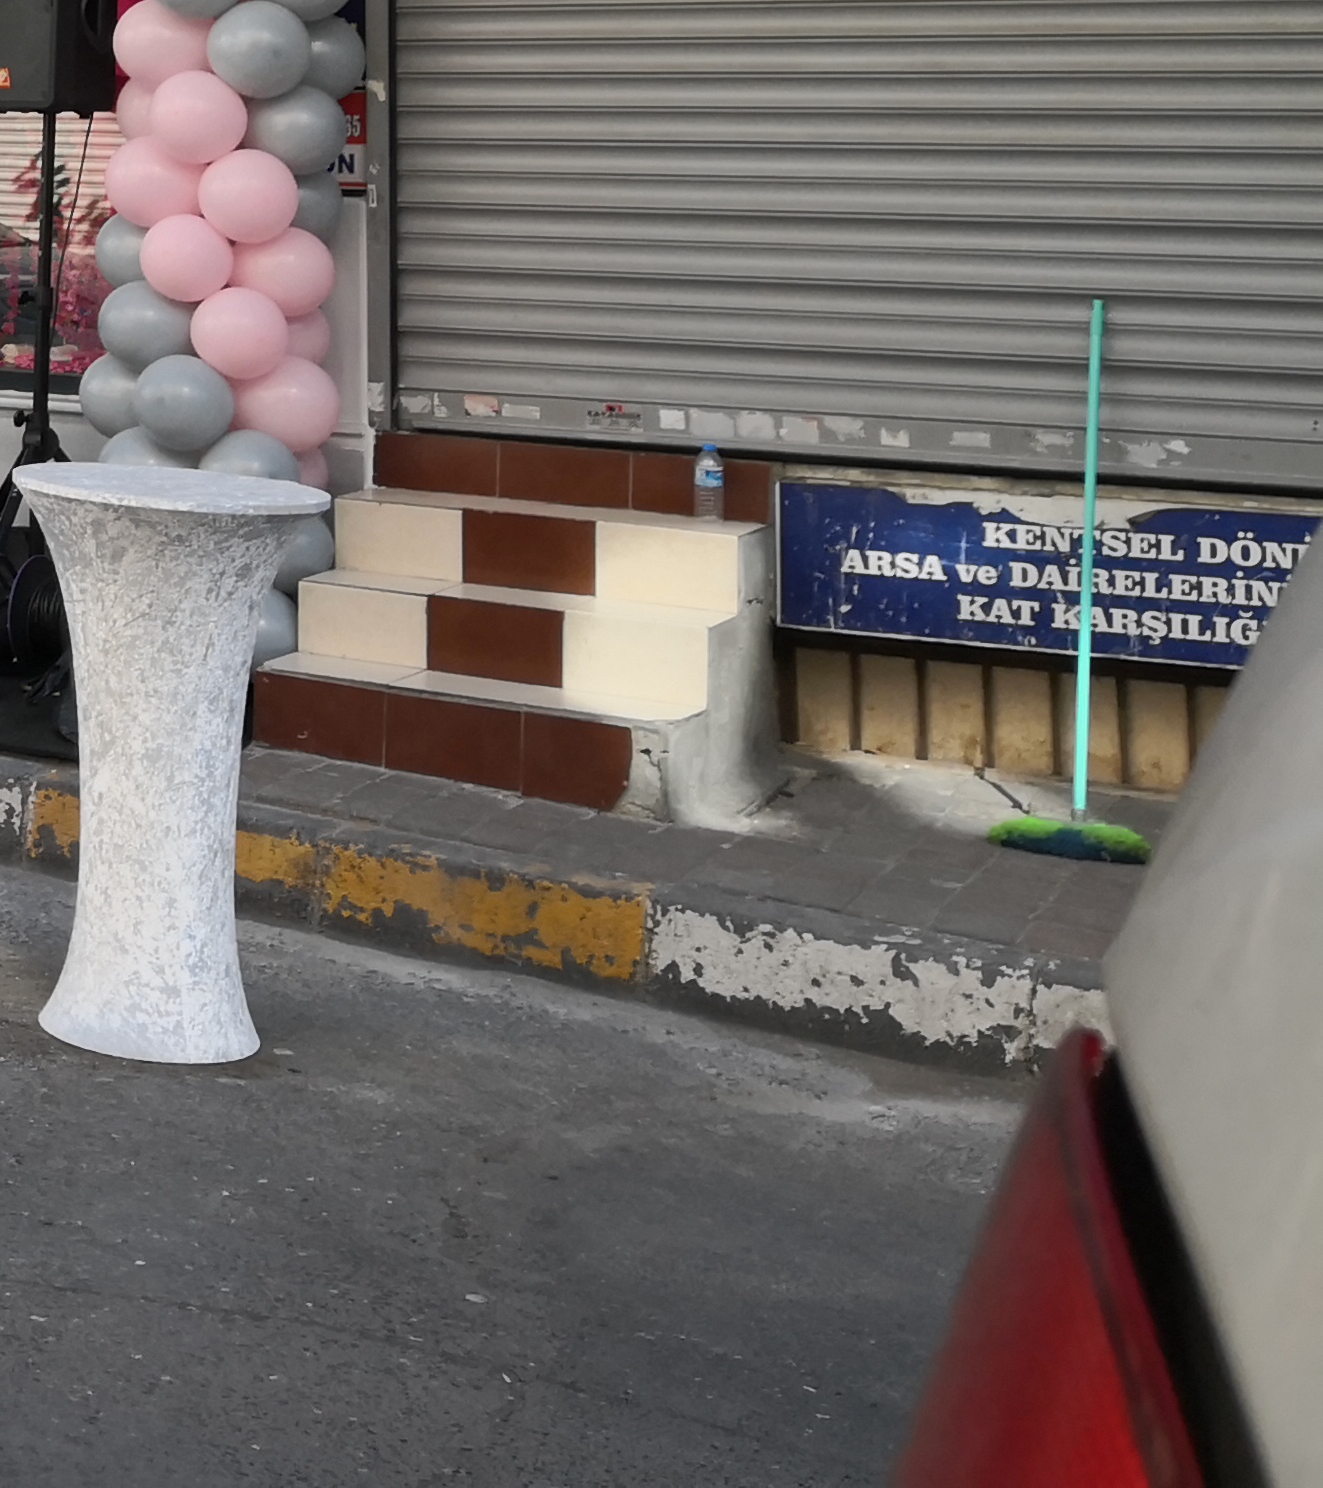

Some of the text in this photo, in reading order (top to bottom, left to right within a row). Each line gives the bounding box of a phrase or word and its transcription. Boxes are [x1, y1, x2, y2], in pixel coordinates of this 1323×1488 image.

[841, 548, 1292, 608] ARSA ve DAİRELERİN
[957, 594, 1267, 646] KAT KARŞILIĞ
